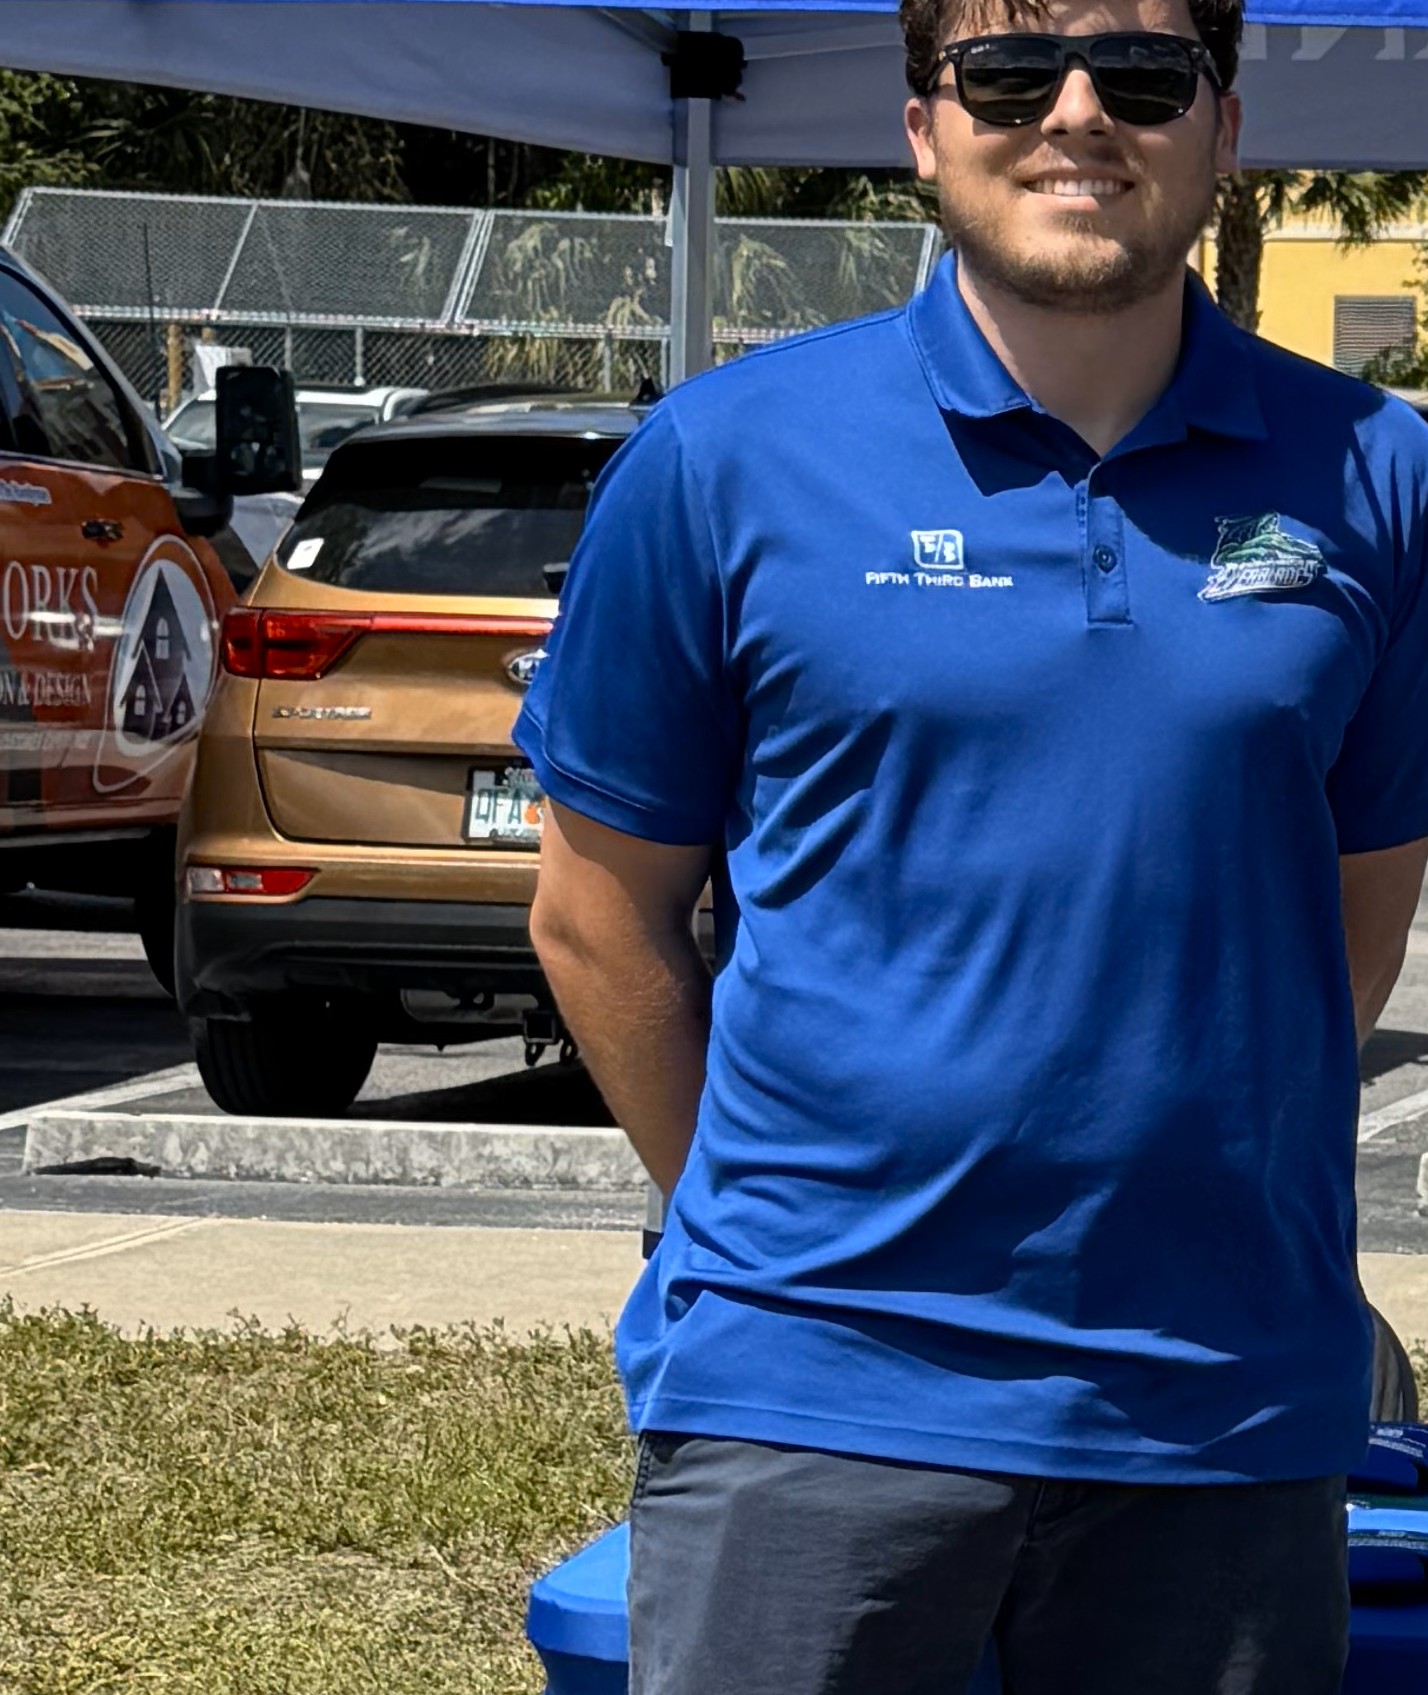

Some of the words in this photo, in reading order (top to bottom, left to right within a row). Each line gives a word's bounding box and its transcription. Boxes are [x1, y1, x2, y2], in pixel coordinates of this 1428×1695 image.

[865, 571, 910, 585] FIFTH
[913, 572, 964, 587] THIRD
[968, 573, 1014, 588] BANK
